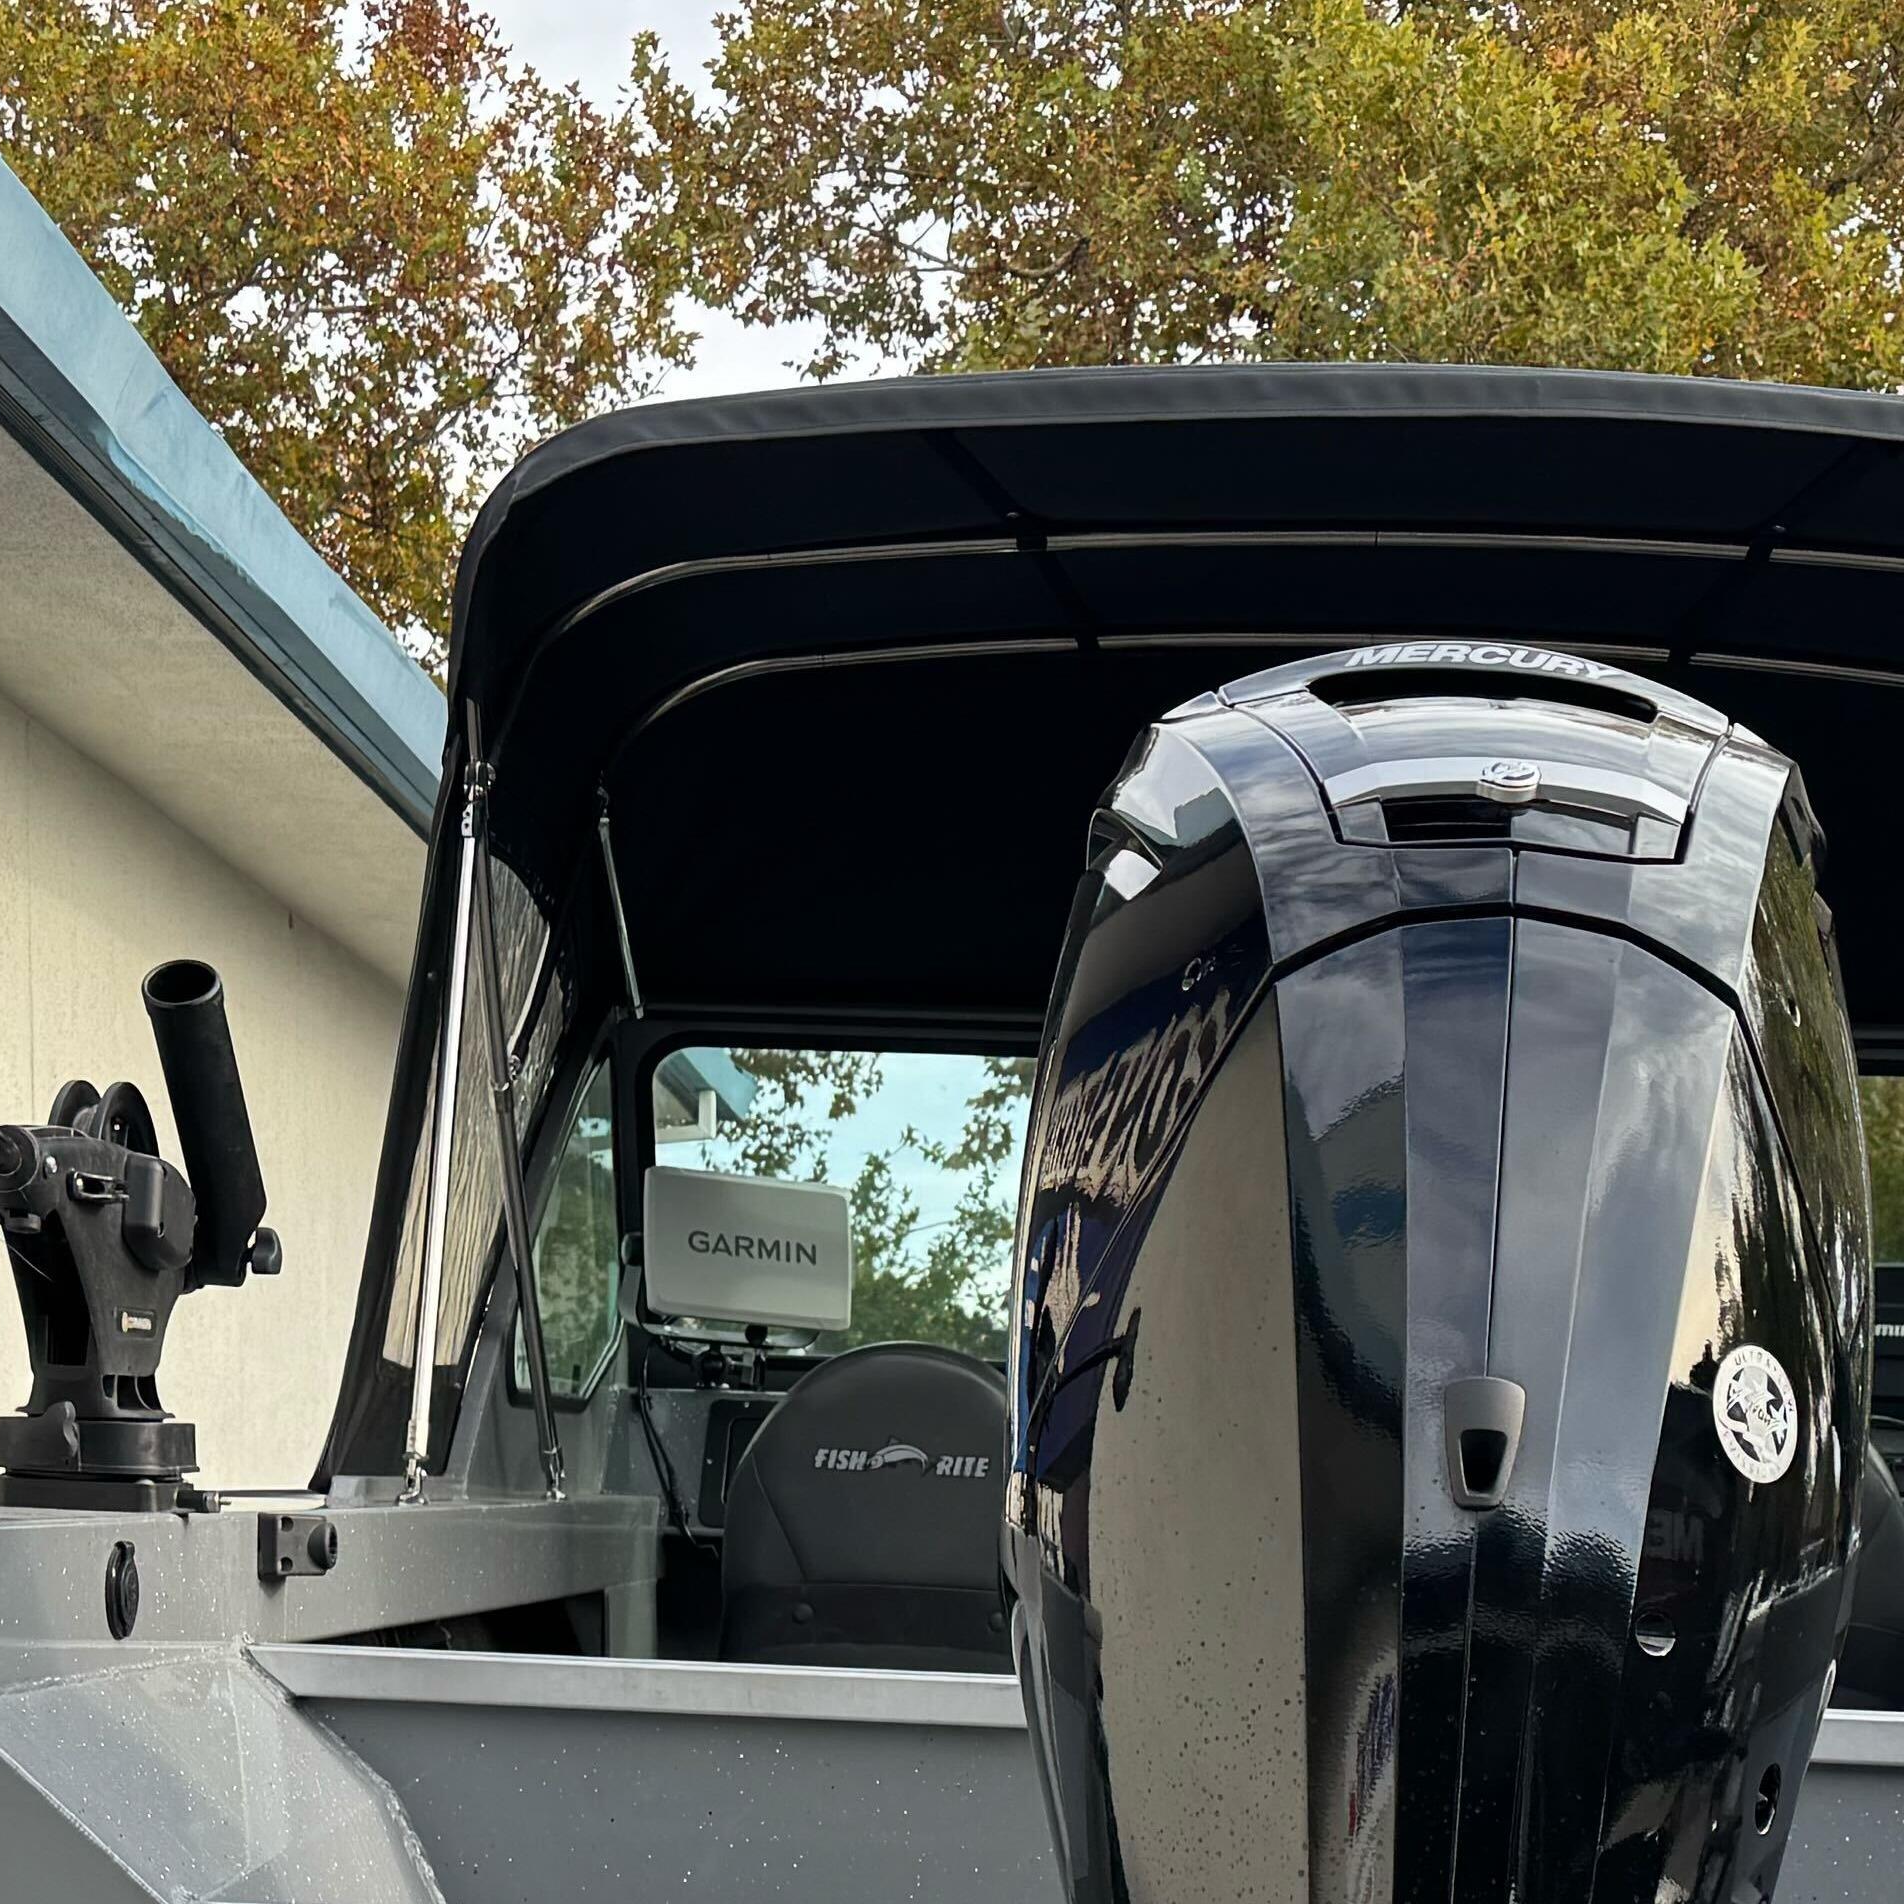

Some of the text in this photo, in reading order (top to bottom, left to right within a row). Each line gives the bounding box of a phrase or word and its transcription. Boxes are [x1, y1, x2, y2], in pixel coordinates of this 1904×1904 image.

[1345, 643, 1619, 679] MERCURY
[687, 1230, 818, 1267] GARMIN
[814, 1448, 990, 1478] FISH RITE
